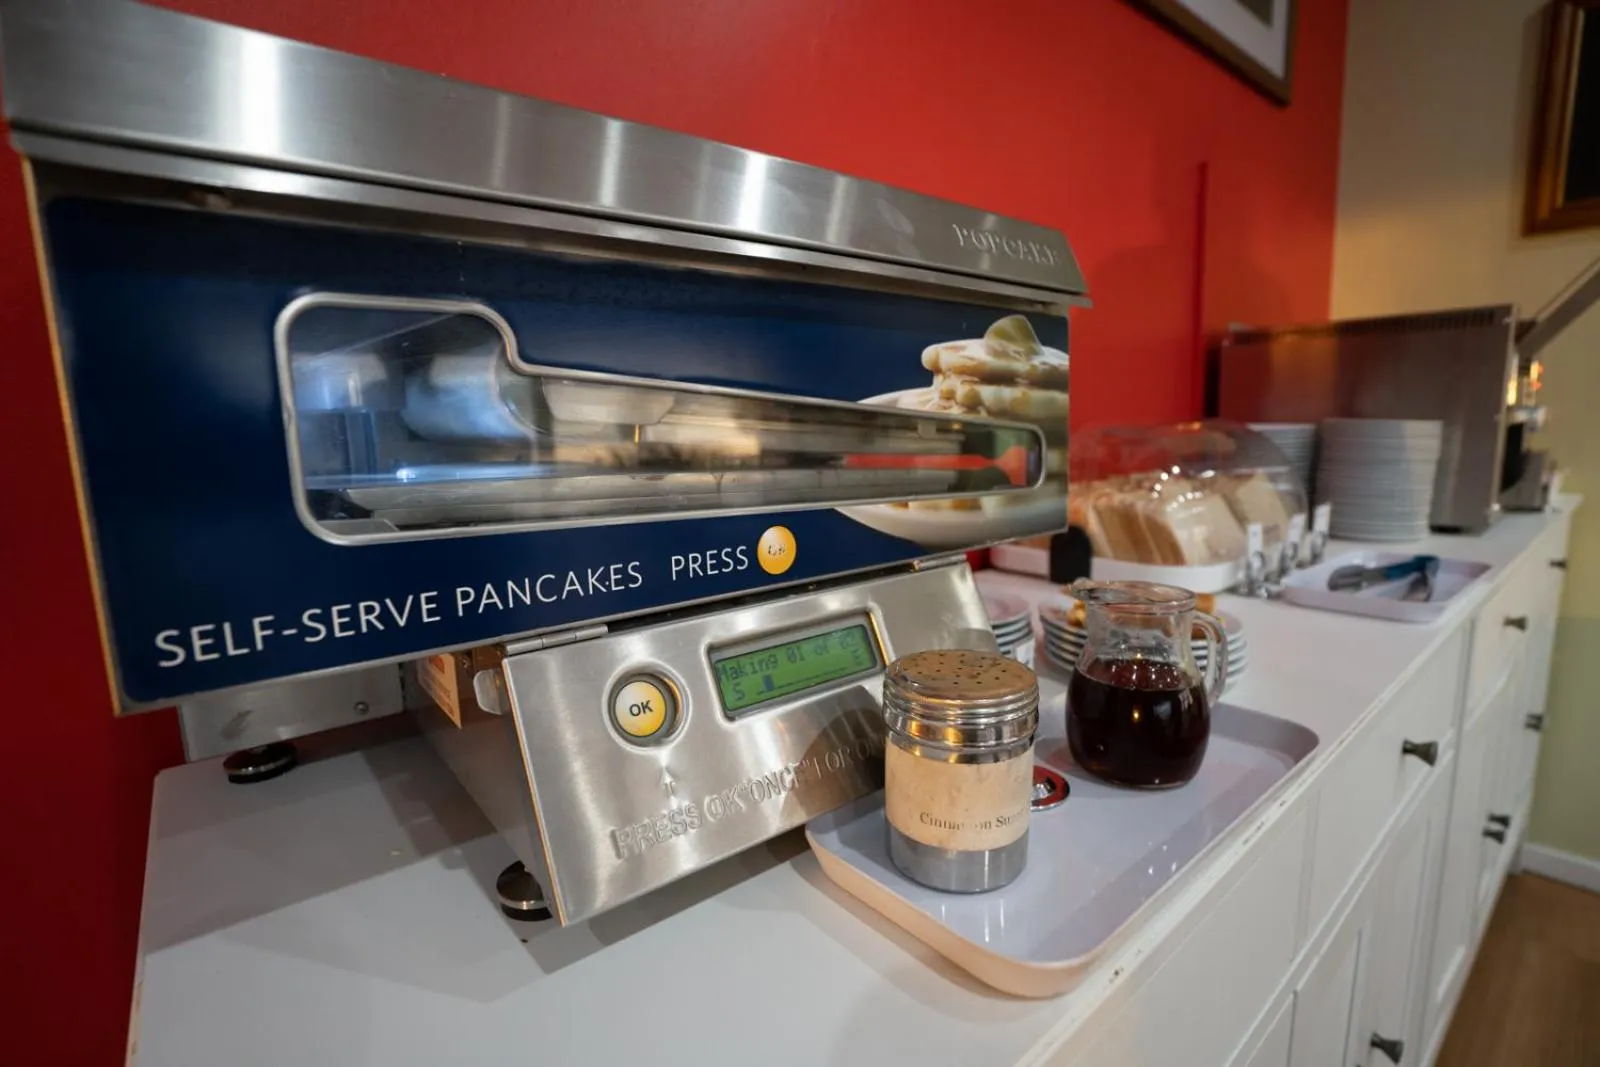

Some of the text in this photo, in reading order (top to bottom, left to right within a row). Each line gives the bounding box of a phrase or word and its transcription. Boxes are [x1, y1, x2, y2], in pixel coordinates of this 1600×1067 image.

[155, 591, 441, 667] SELF-SERVE
[455, 561, 643, 617] PANCAKES
[671, 545, 749, 580] PRESS
[717, 653, 779, 683] Making
[629, 699, 654, 717] OK
[609, 802, 702, 860] PRESS
[703, 787, 747, 822] OK
[919, 811, 992, 831] Cinnaon
